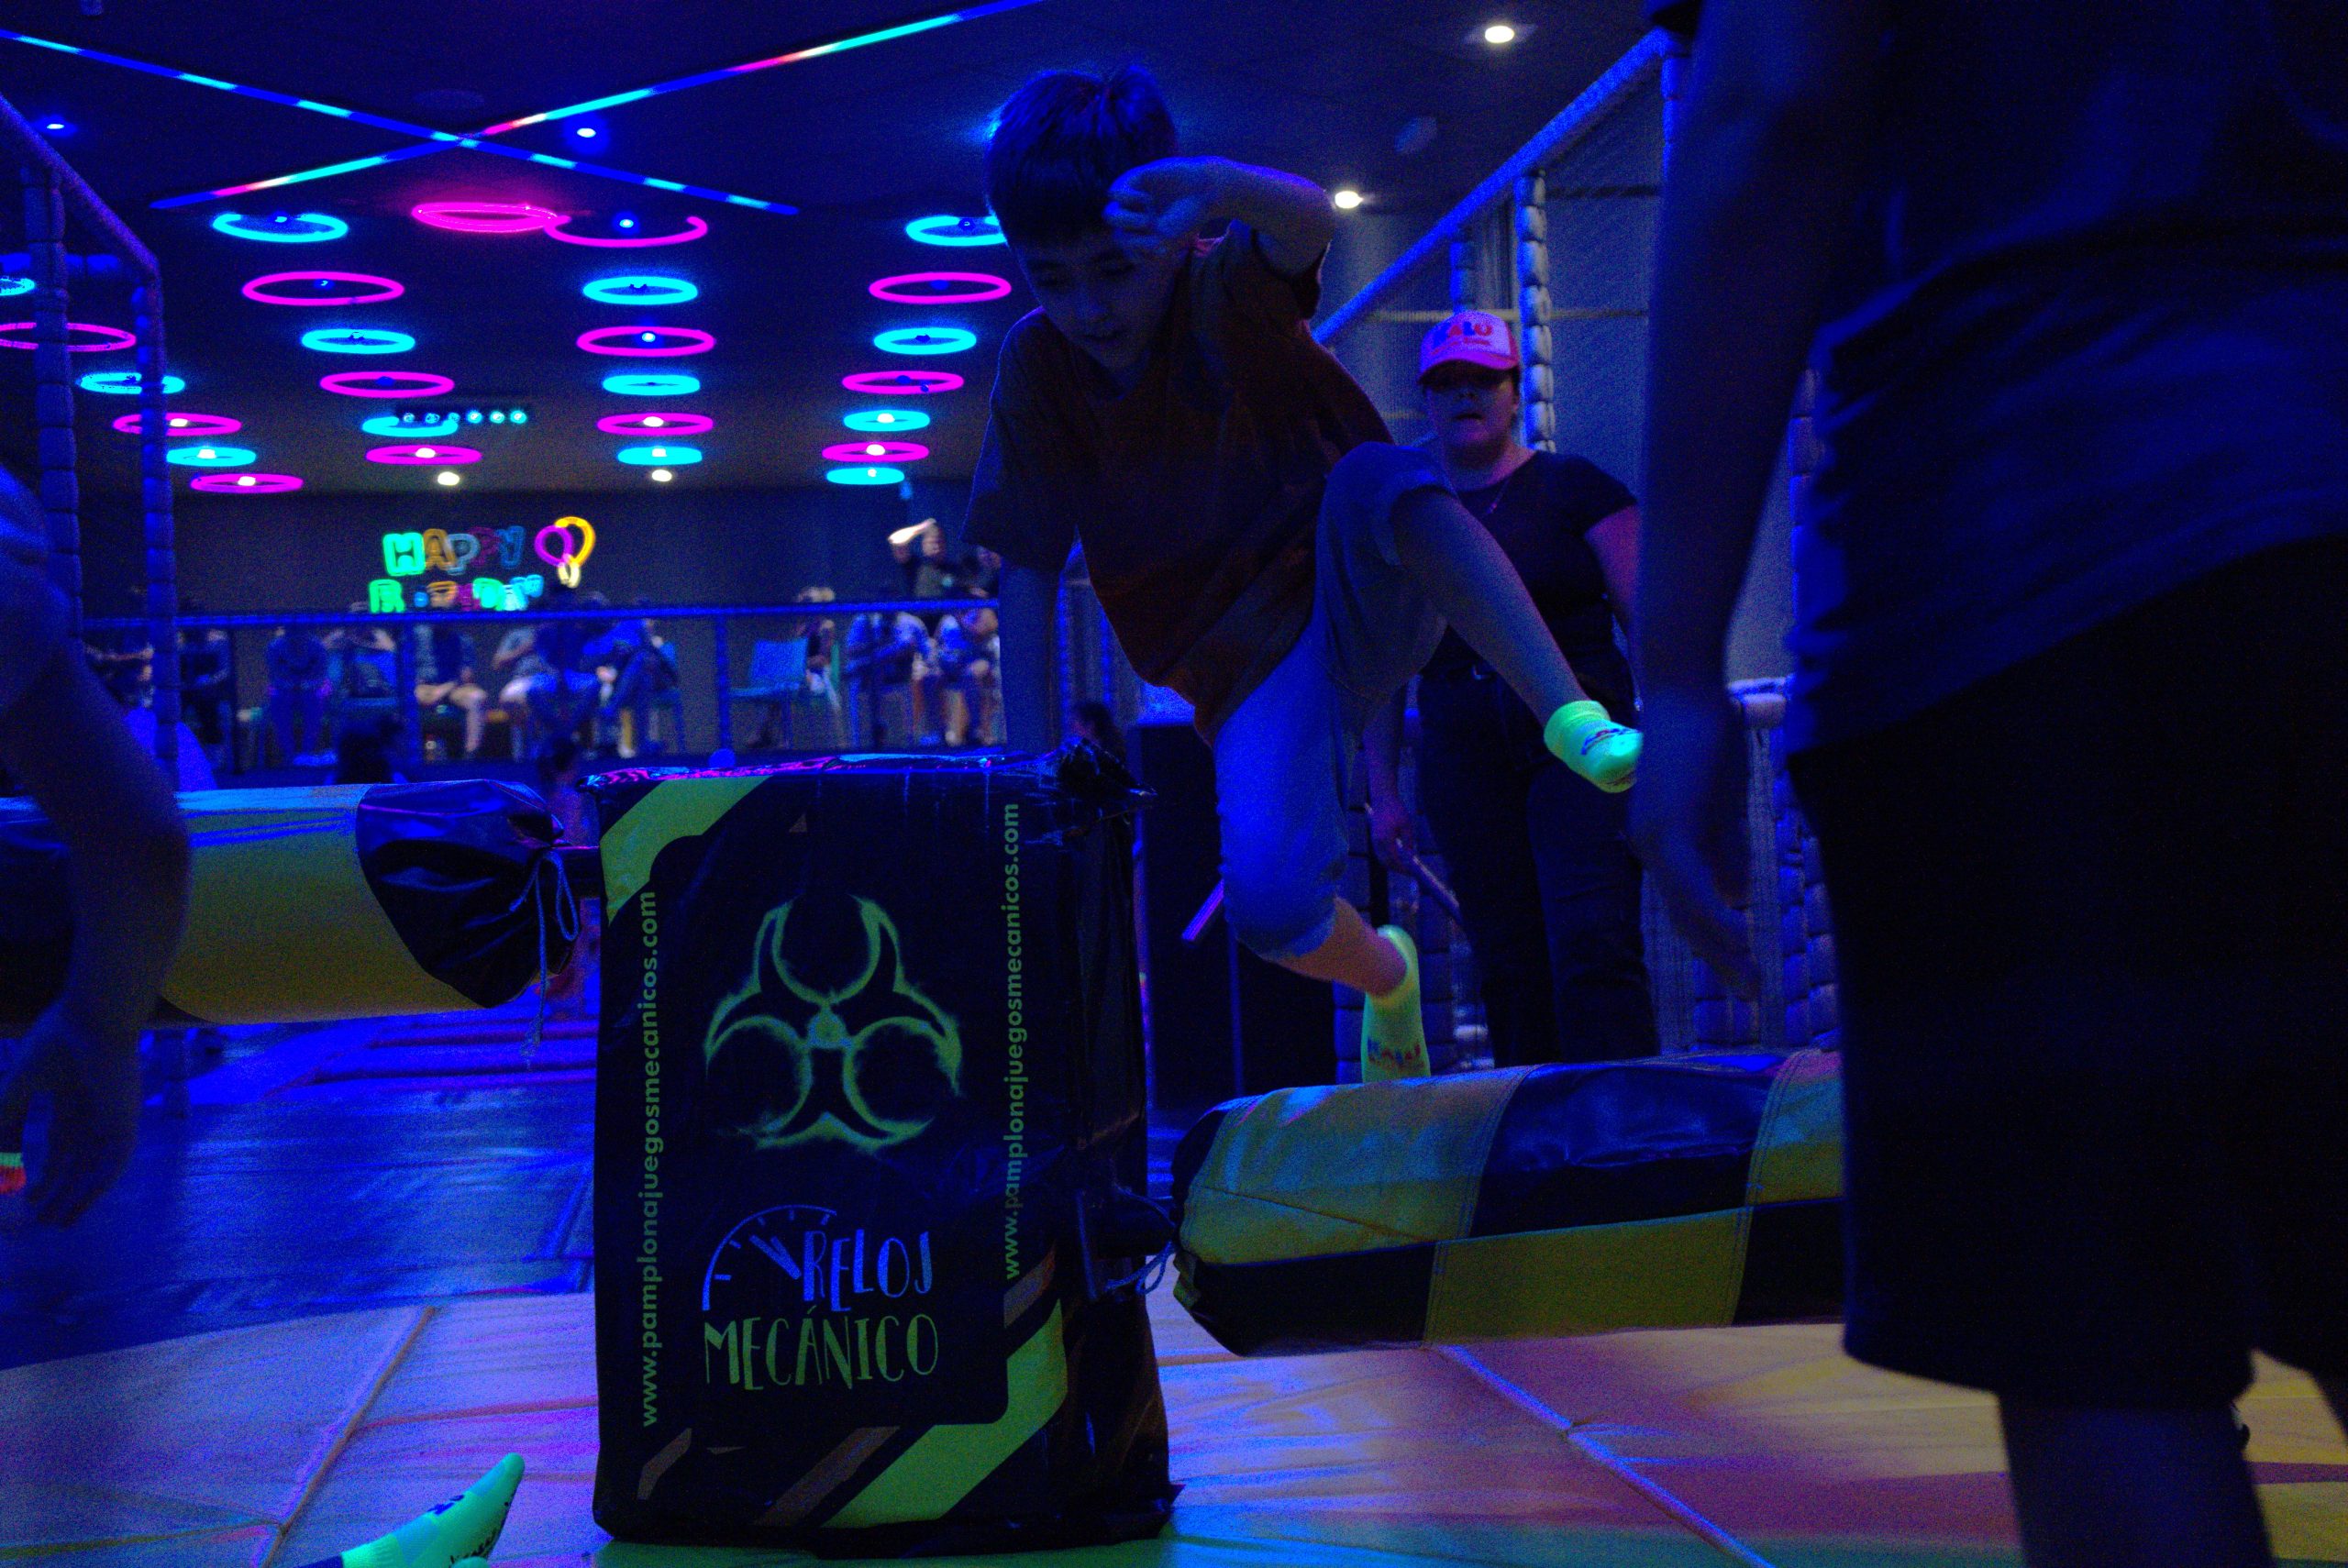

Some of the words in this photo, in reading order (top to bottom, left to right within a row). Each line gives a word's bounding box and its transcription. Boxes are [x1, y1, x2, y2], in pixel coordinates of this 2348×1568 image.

[382, 525, 526, 577] HAPPY
[1001, 803, 1029, 1280] www.pamplonajuegosmecanicos.com
[637, 891, 664, 1428] www.pamplonajuegosmecanicos.com
[803, 1228, 934, 1312] RELOJ
[703, 1304, 939, 1390] MECÁNICO
